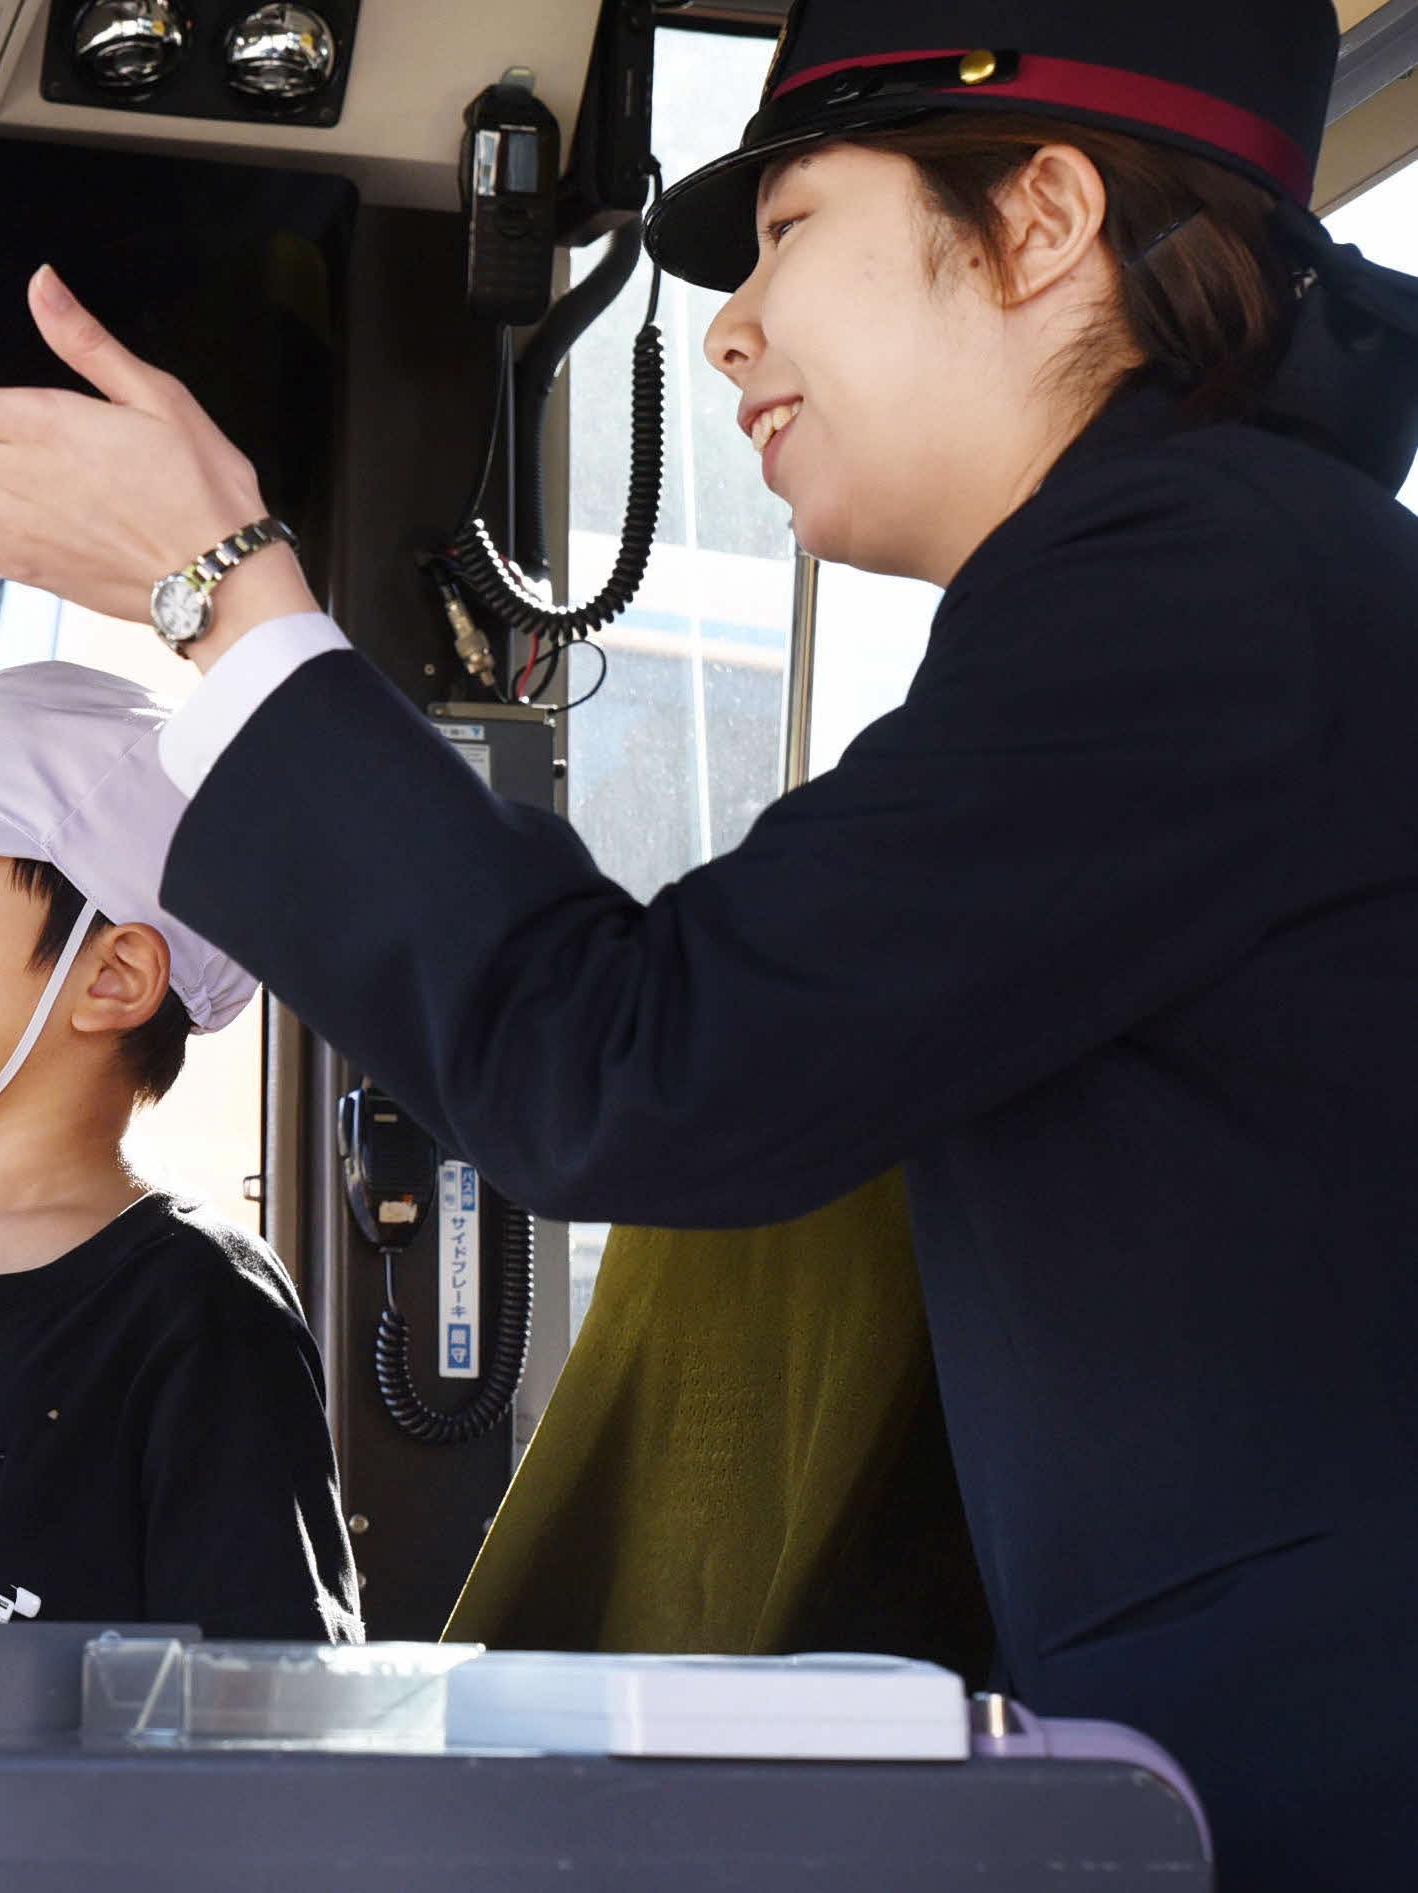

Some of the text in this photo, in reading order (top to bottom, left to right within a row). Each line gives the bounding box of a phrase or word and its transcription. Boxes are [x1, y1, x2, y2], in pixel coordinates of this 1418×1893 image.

[450, 1216, 468, 1319] サイドブレーキ
